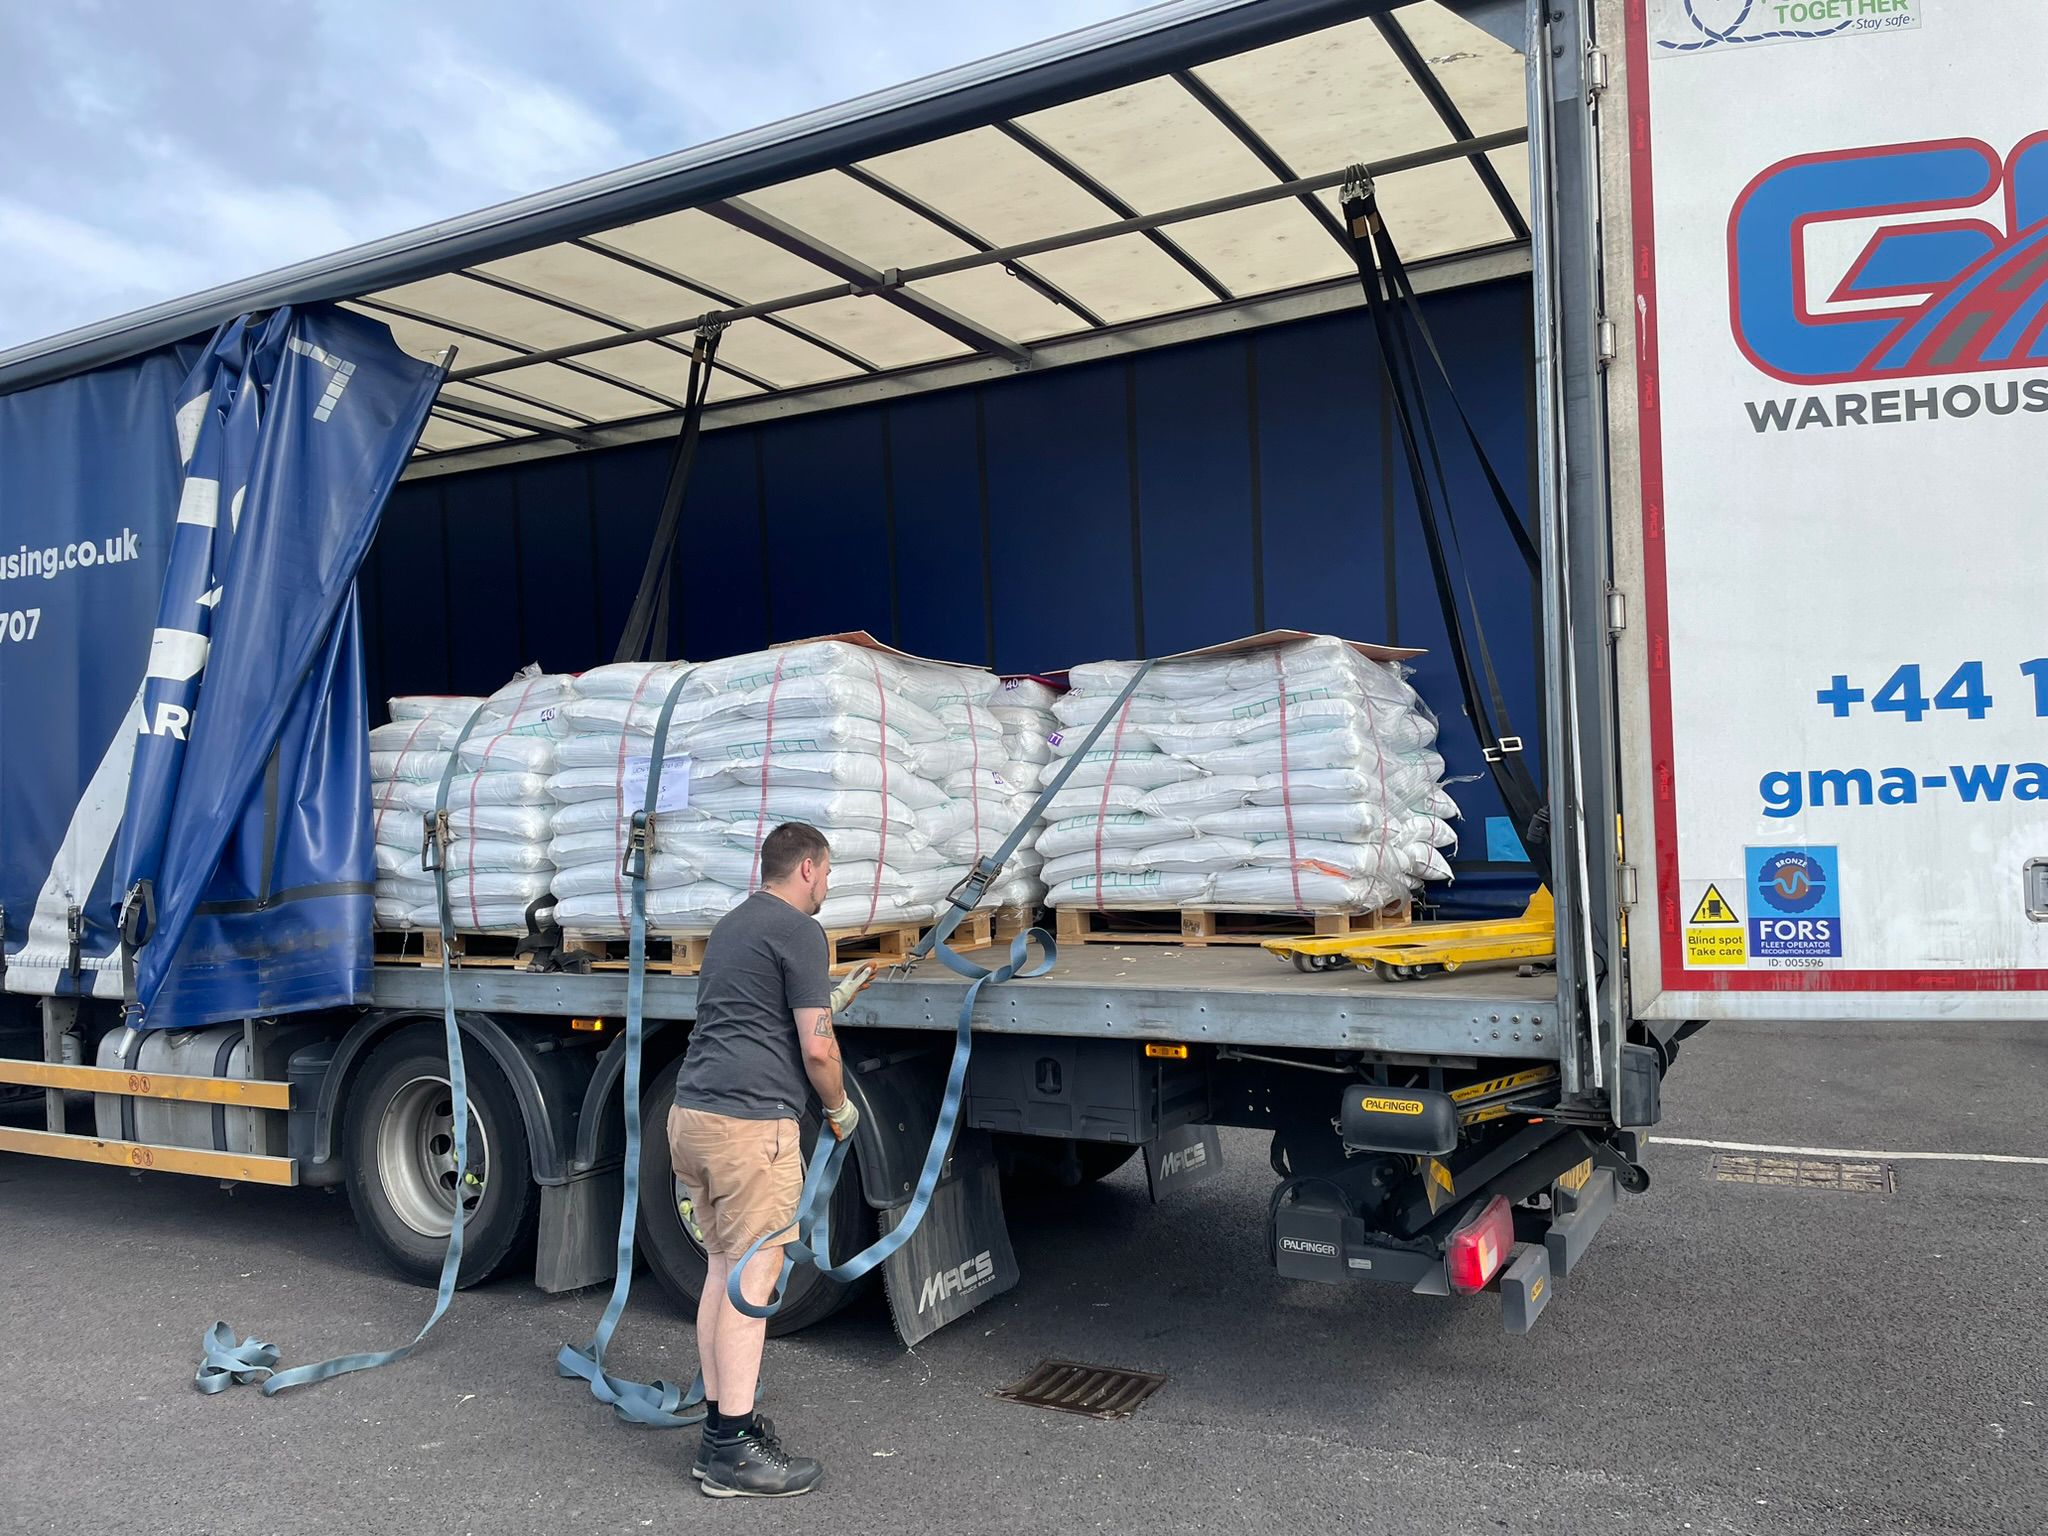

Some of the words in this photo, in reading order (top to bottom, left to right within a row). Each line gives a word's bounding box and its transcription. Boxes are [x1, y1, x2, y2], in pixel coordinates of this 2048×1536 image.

[1744, 378, 2048, 433] WAREHOUS
[1816, 660, 1993, 722] +44
[1759, 762, 2048, 819] gma-wa
[1775, 858, 1807, 868] BRONZE
[1759, 920, 1830, 940] FORS
[1688, 936, 1715, 944] Blind
[1719, 937, 1743, 946] spot
[1690, 948, 1716, 956] Take
[1768, 959, 1782, 967] ID:
[1785, 958, 1824, 967] 005596
[1365, 1099, 1419, 1113] PALFINGER
[1283, 1239, 1336, 1256] PALFINGER
